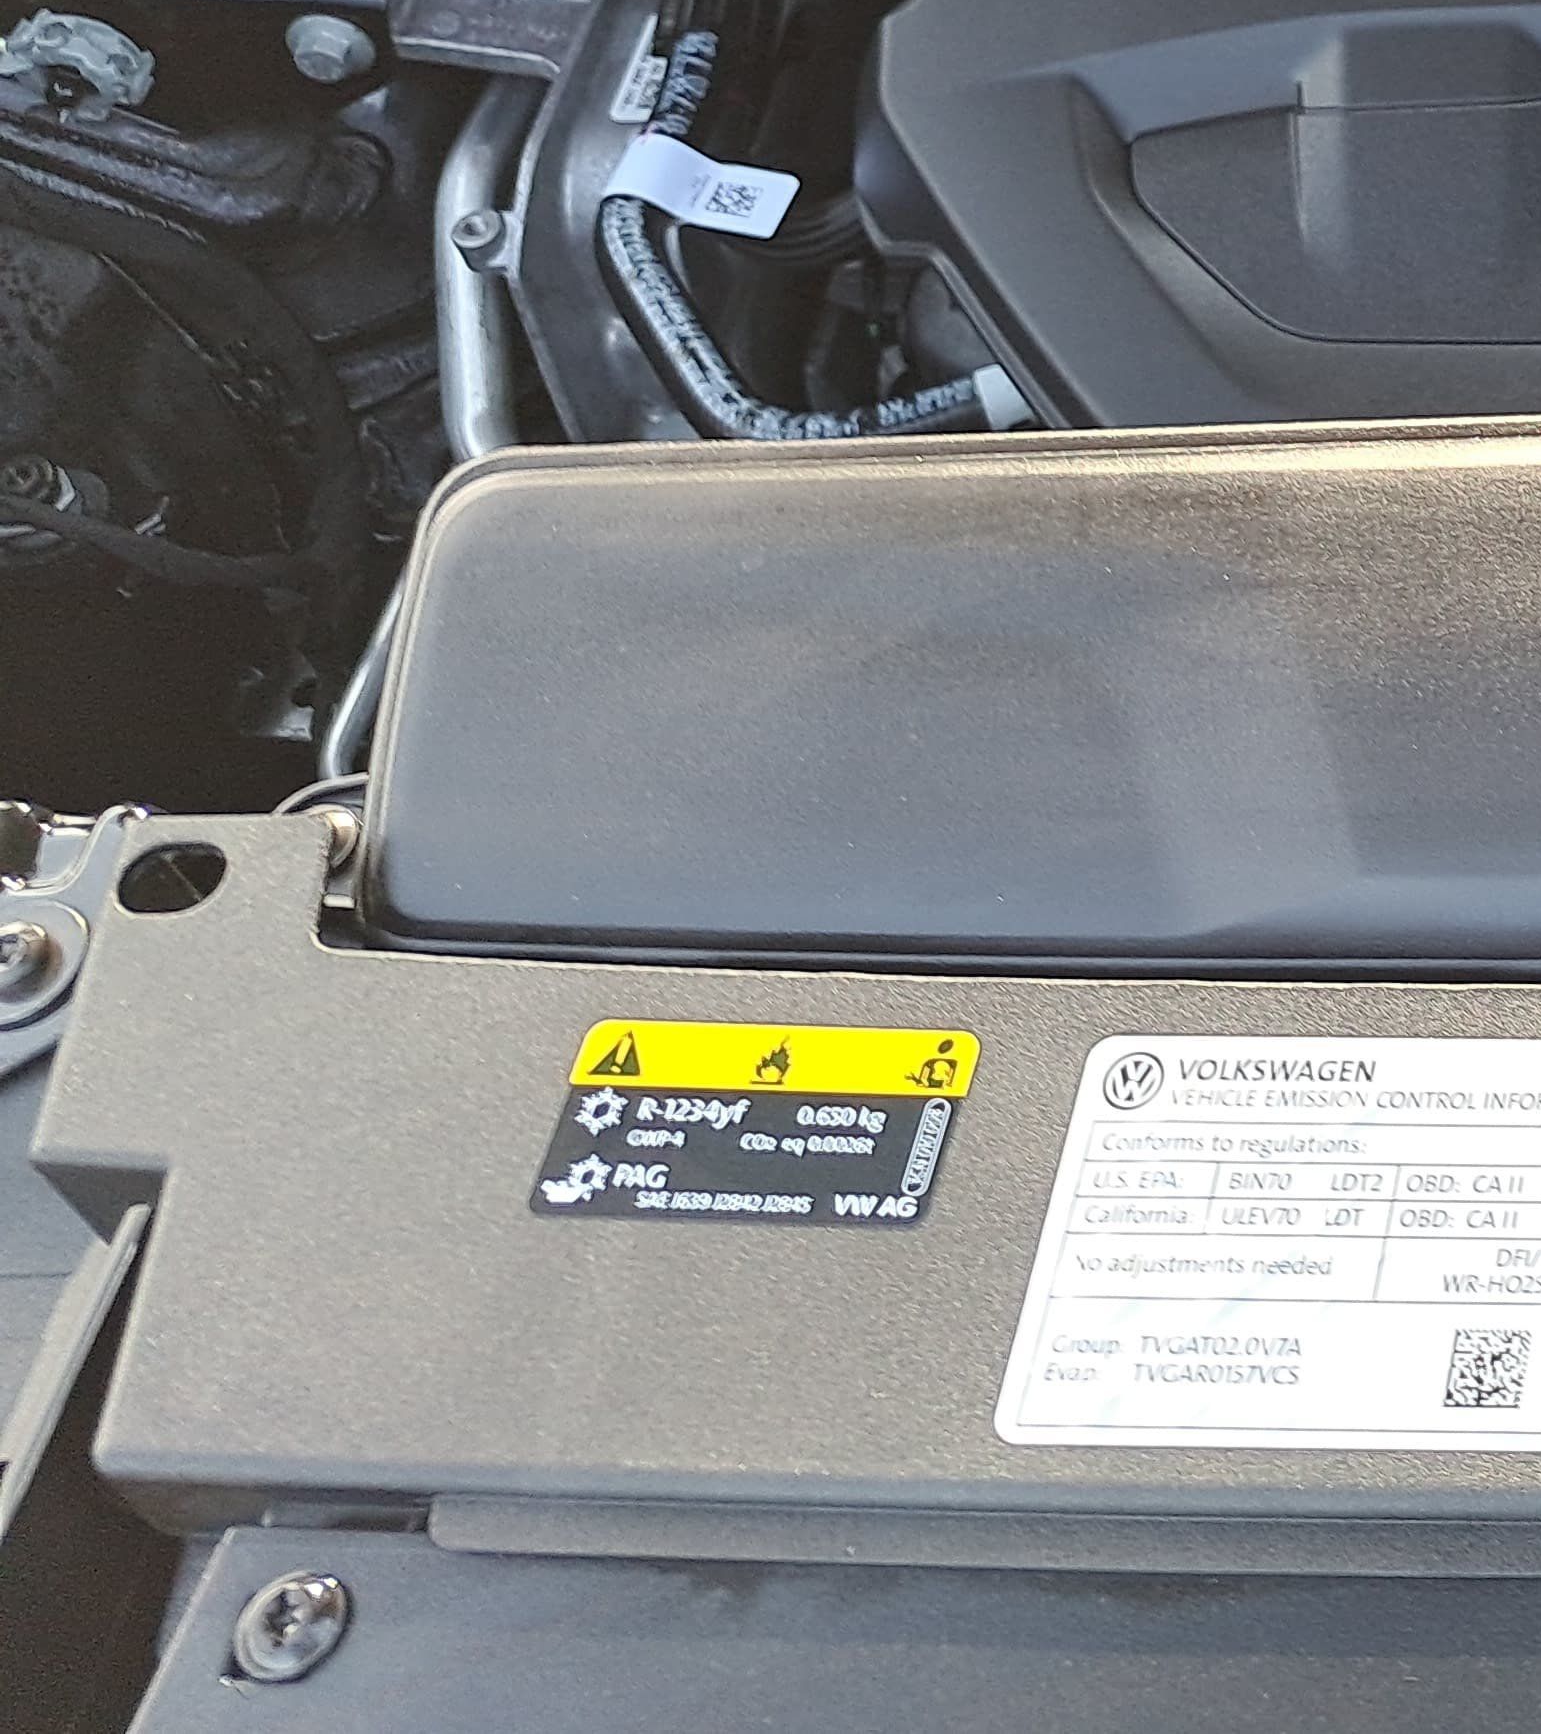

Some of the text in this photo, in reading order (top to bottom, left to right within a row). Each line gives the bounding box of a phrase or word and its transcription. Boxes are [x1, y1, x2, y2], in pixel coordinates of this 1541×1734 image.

[1179, 1059, 1376, 1082] VOLKSWAGEN
[1264, 1089, 1367, 1107] EMISSION
[1376, 1090, 1475, 1110] CONTROL
[637, 1097, 751, 1129] R-1234yf
[1101, 1133, 1366, 1158] Conforms to regulations:
[612, 1163, 670, 1189] PAG
[1228, 1172, 1383, 1191] BIN70 LDT2
[1405, 1174, 1459, 1193] OBD:
[1472, 1174, 1501, 1193] CA
[832, 1194, 879, 1217] VW
[879, 1196, 919, 1219] AG
[1221, 1206, 1301, 1225] ULEV70
[1399, 1208, 1454, 1227] OBD:
[1465, 1209, 1496, 1228] CA
[1251, 1255, 1332, 1275] needed
